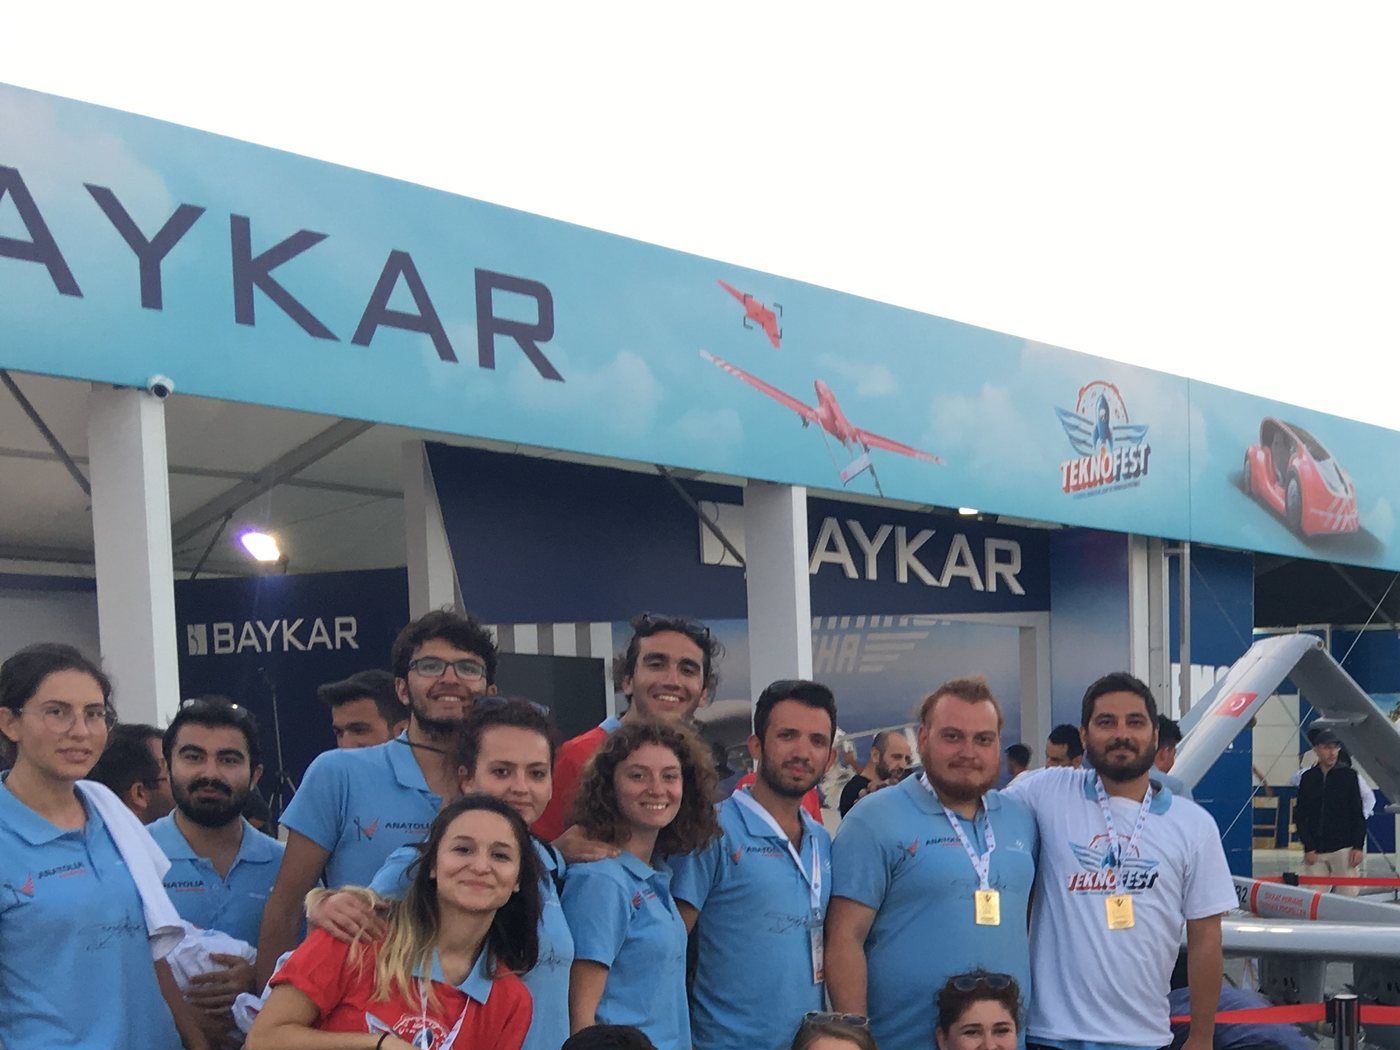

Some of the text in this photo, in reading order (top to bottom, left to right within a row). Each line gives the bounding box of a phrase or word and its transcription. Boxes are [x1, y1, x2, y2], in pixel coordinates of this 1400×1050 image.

[1060, 443, 1151, 495] TEKNOFEST
[808, 516, 1026, 596] AYKAR
[212, 615, 360, 655] BAYKAR
